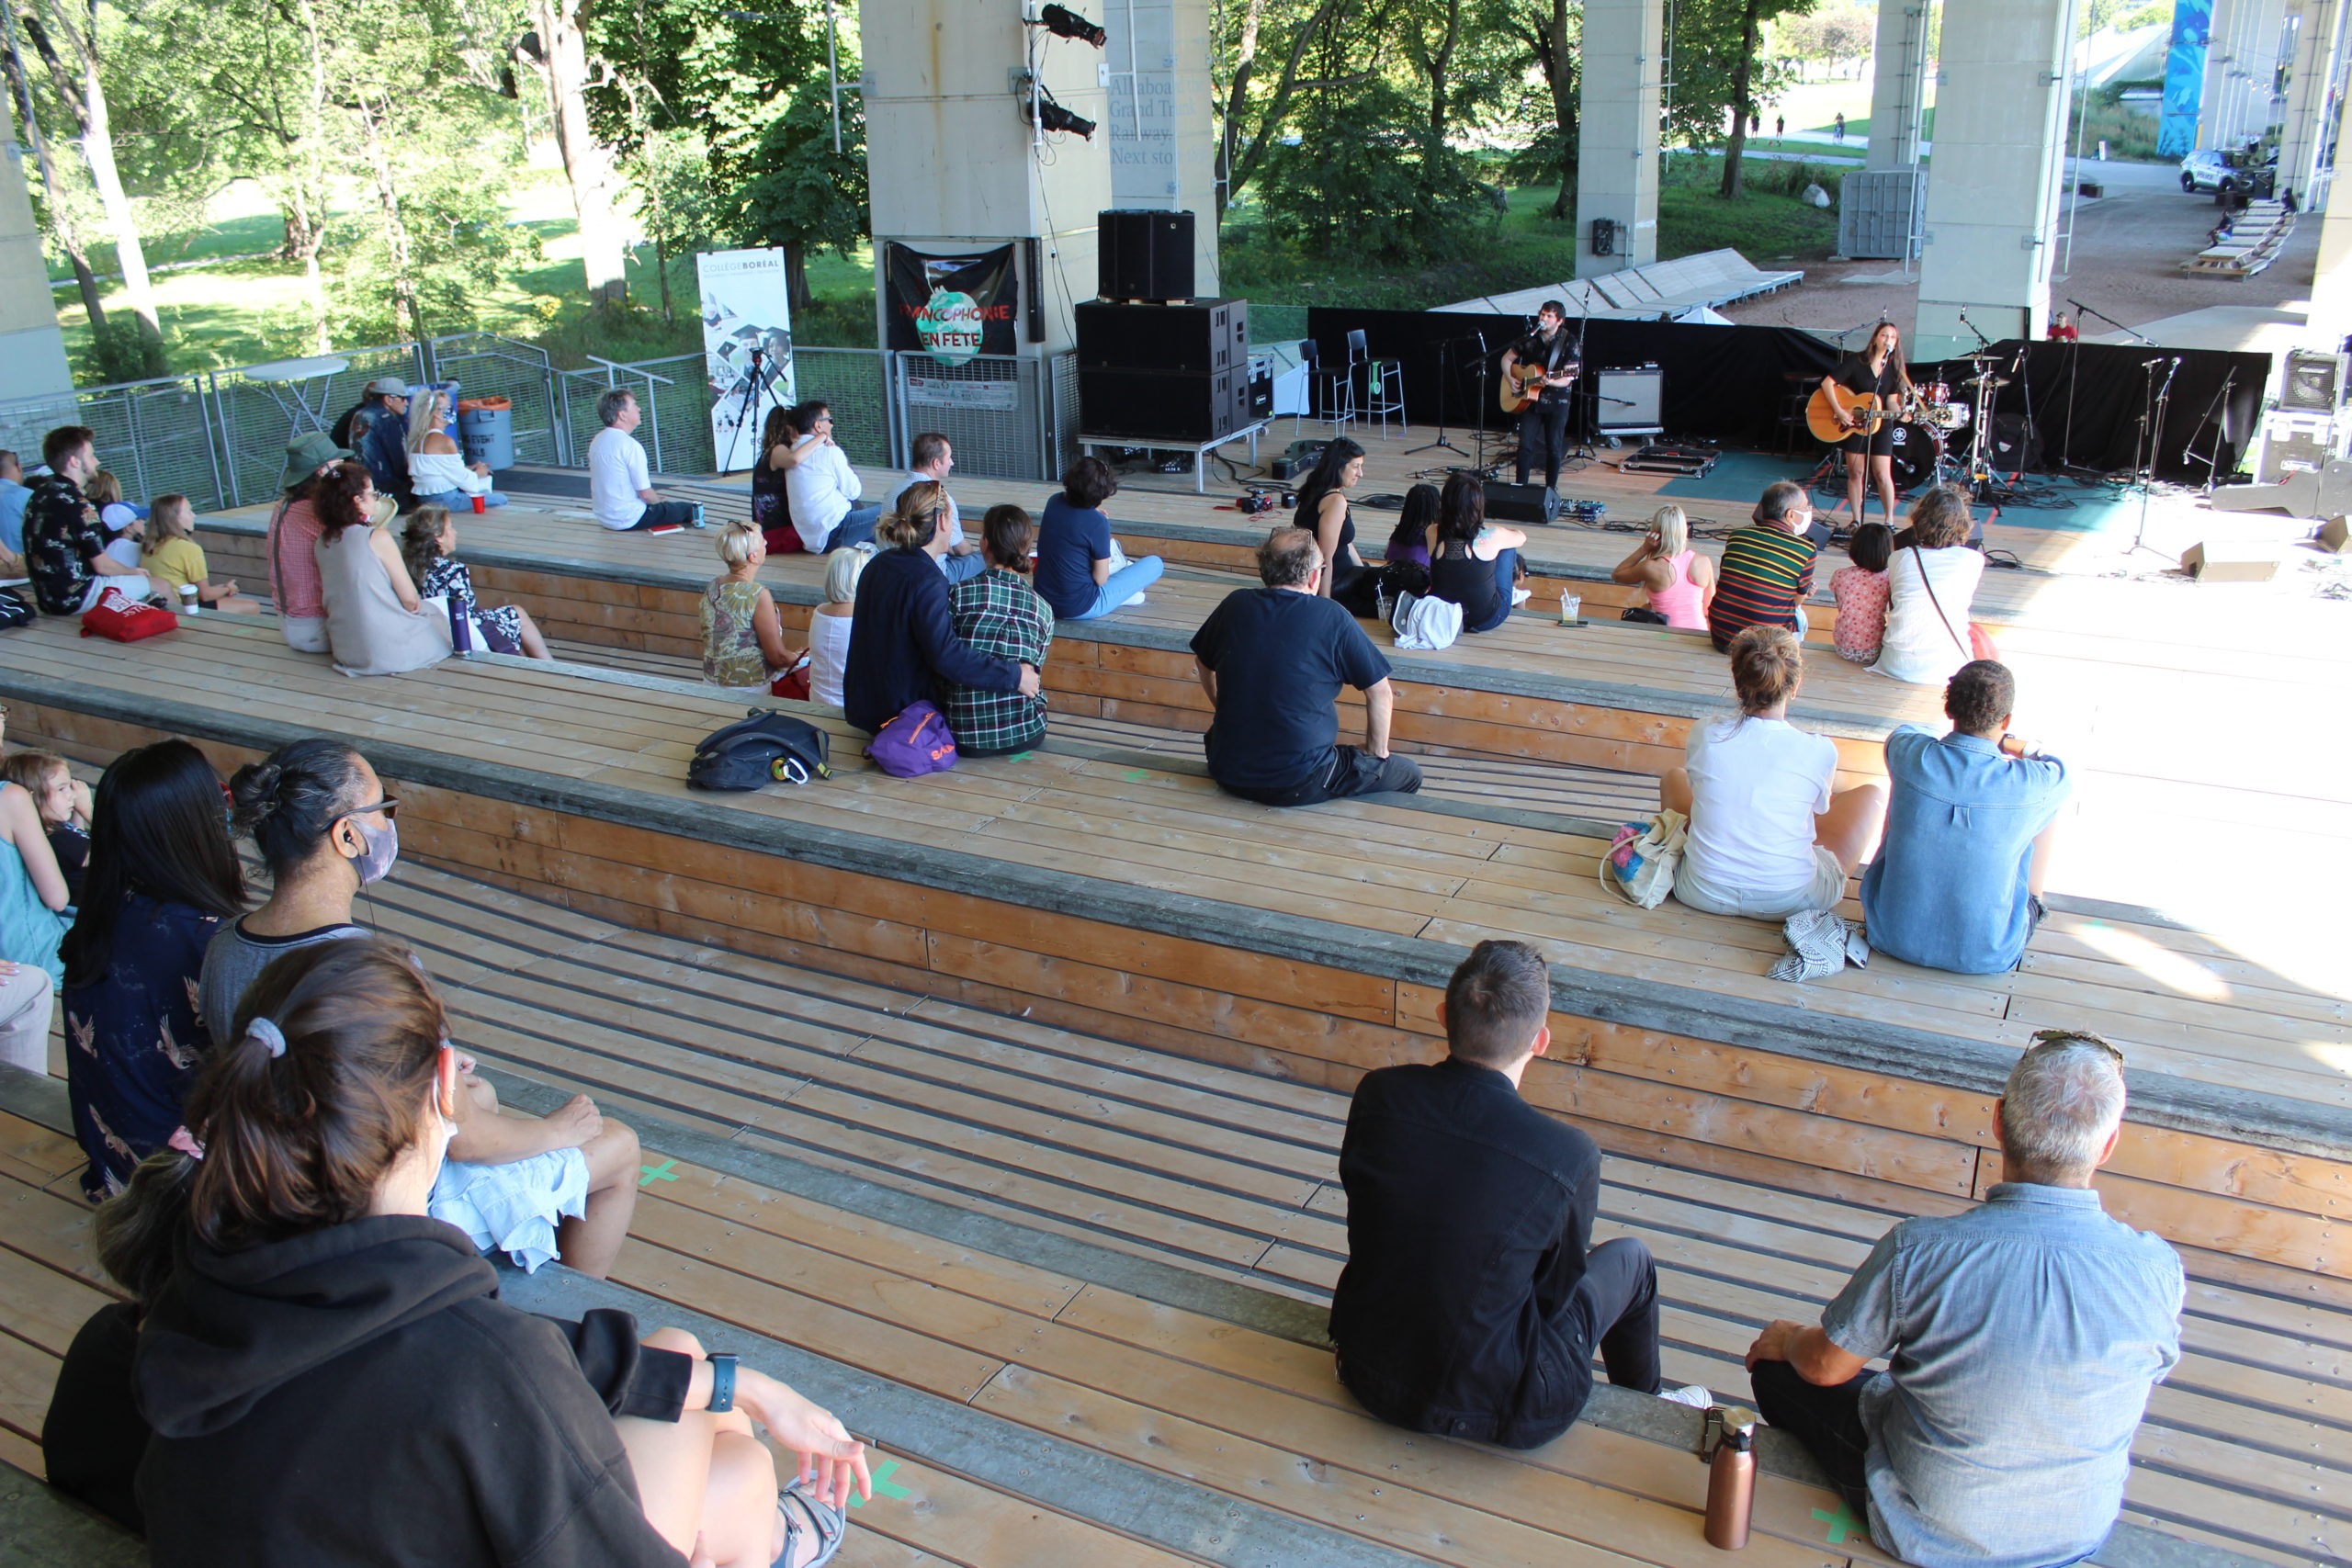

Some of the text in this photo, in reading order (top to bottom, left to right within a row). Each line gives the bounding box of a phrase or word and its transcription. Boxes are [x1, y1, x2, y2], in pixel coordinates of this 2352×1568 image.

[1109, 98, 1154, 118] Grand
[1110, 124, 1172, 146] Raiway.
[1111, 147, 1147, 164] Next
[921, 332, 941, 348] EN
